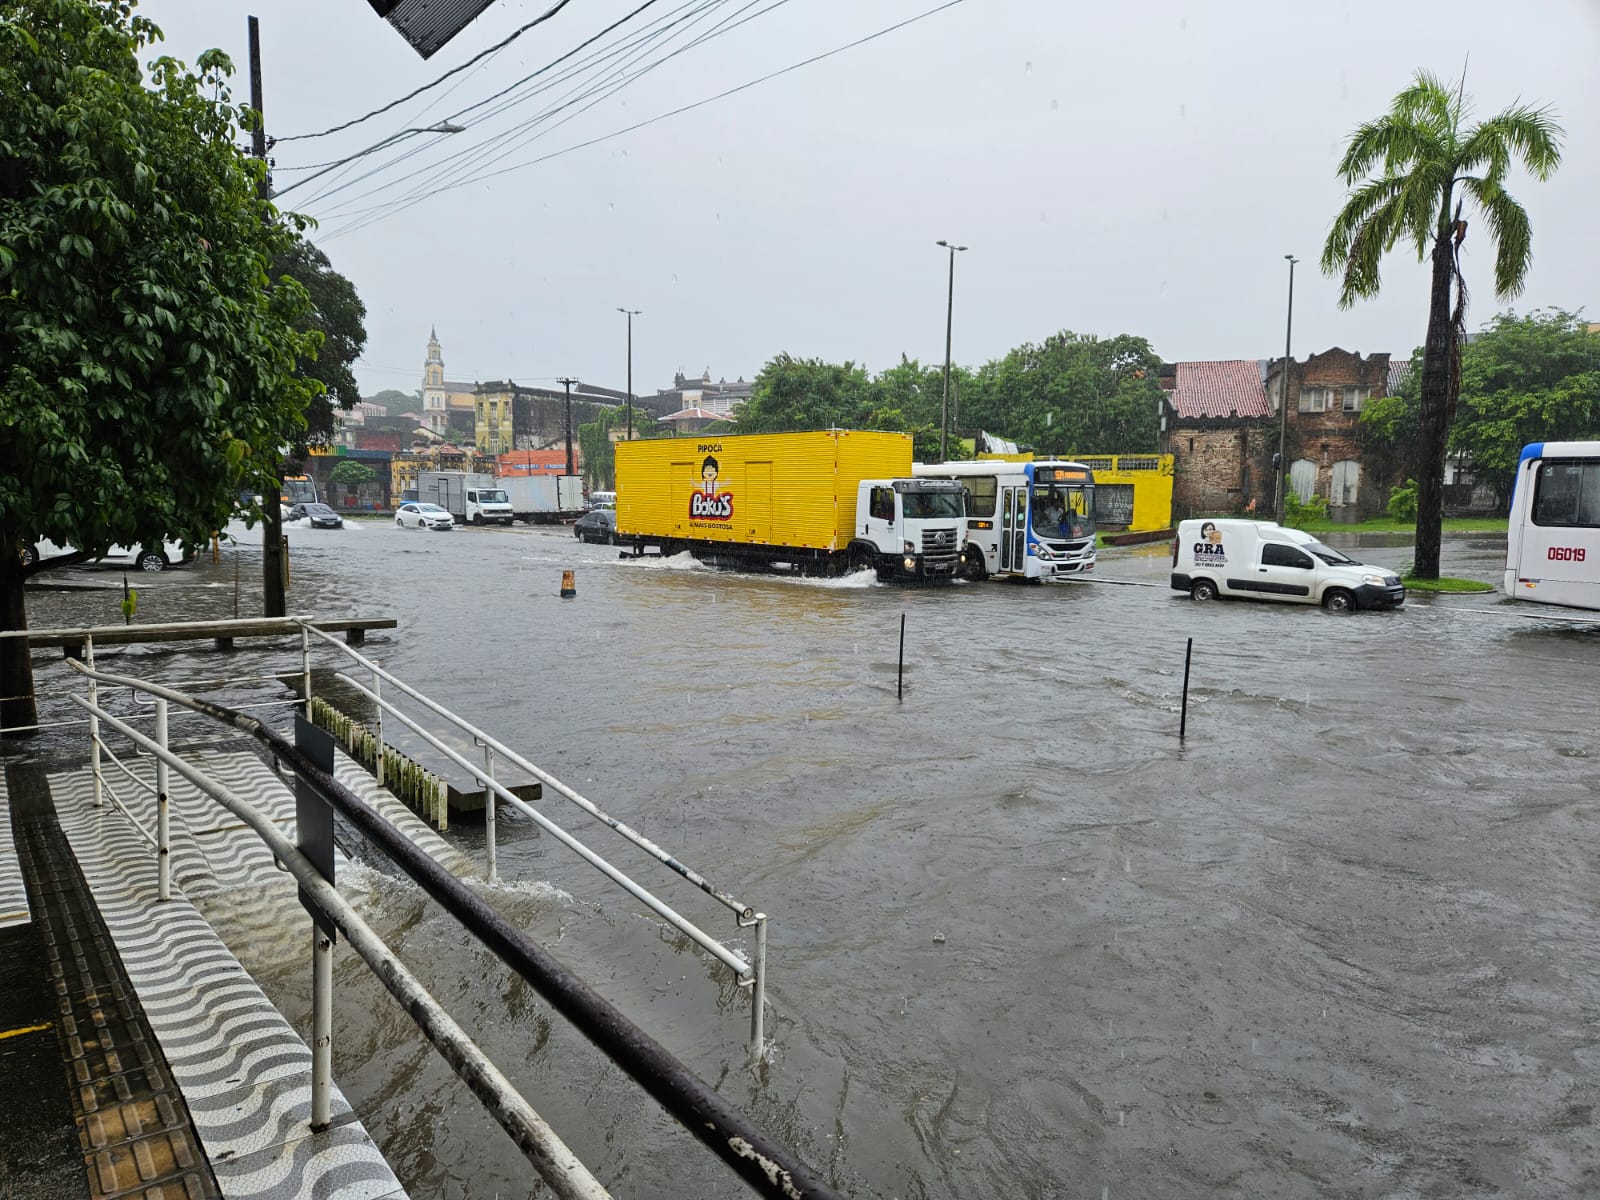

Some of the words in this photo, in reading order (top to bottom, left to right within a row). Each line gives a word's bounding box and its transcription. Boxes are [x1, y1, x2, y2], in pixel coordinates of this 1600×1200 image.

[698, 444, 722, 453] PIPOCA
[1193, 542, 1225, 555] GRA
[1547, 547, 1586, 562] 06019
